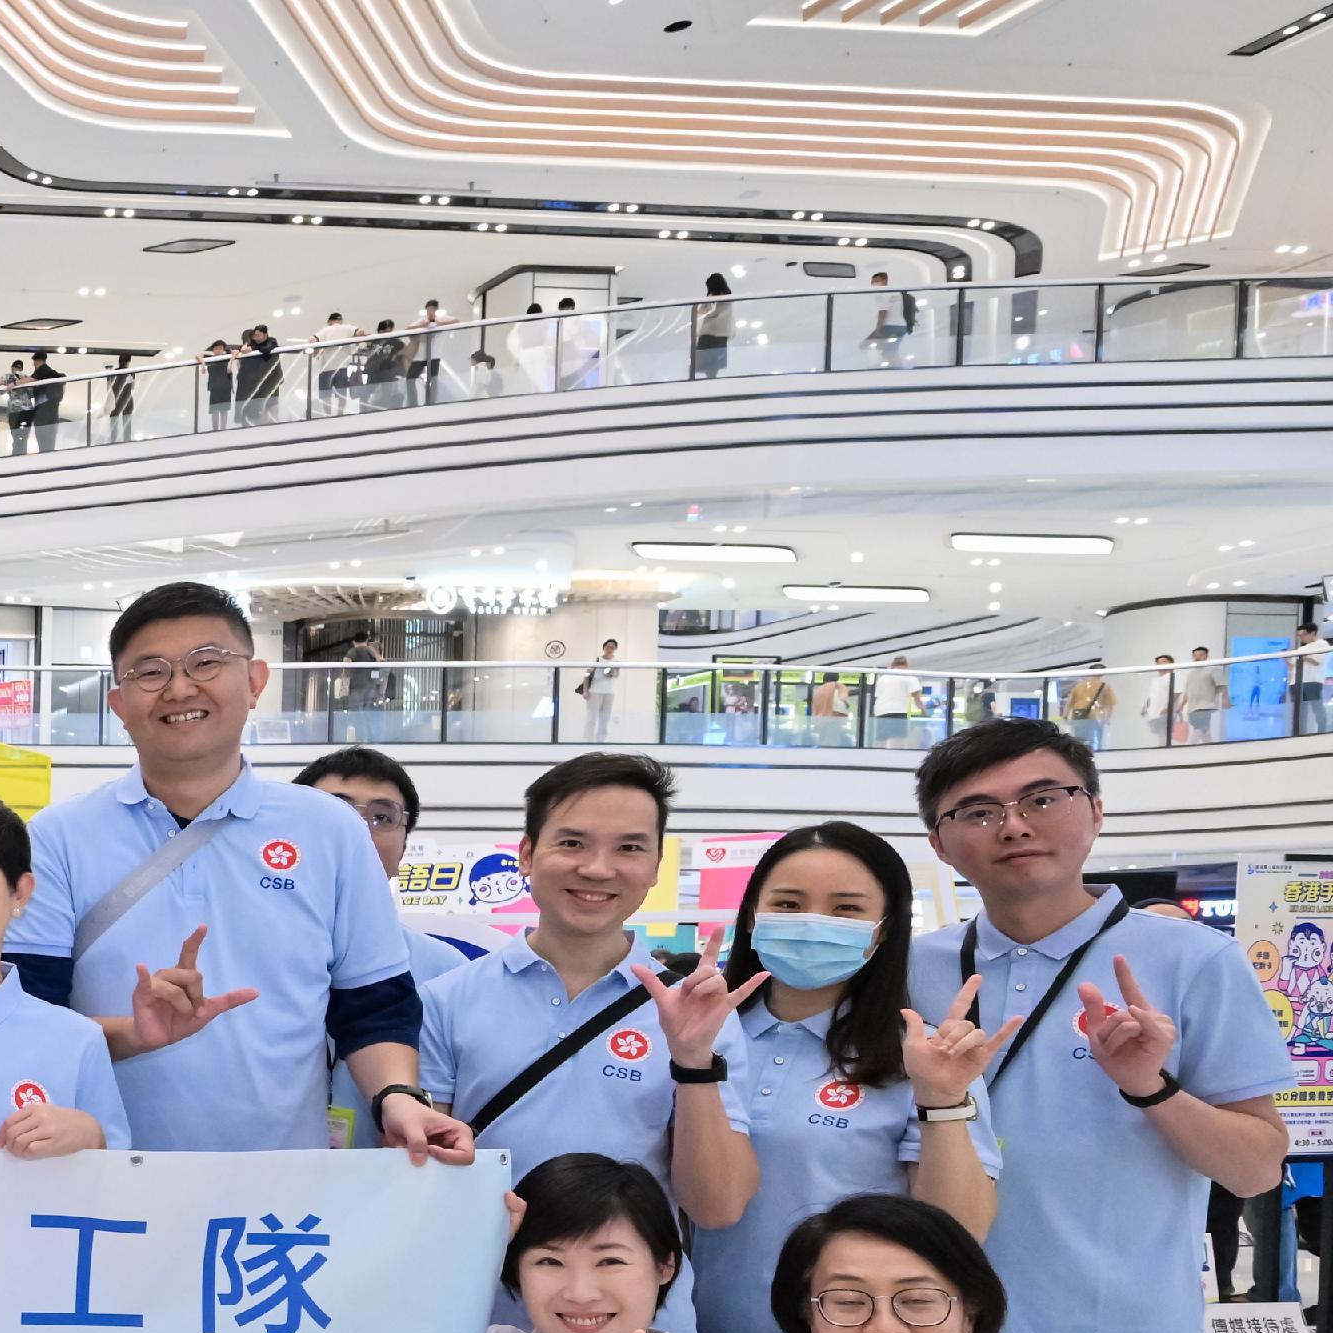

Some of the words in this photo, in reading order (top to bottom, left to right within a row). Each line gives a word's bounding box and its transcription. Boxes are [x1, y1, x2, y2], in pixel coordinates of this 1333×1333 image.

[259, 876, 295, 891] CSB
[602, 1064, 642, 1082] CSB
[807, 1112, 849, 1130] CSB
